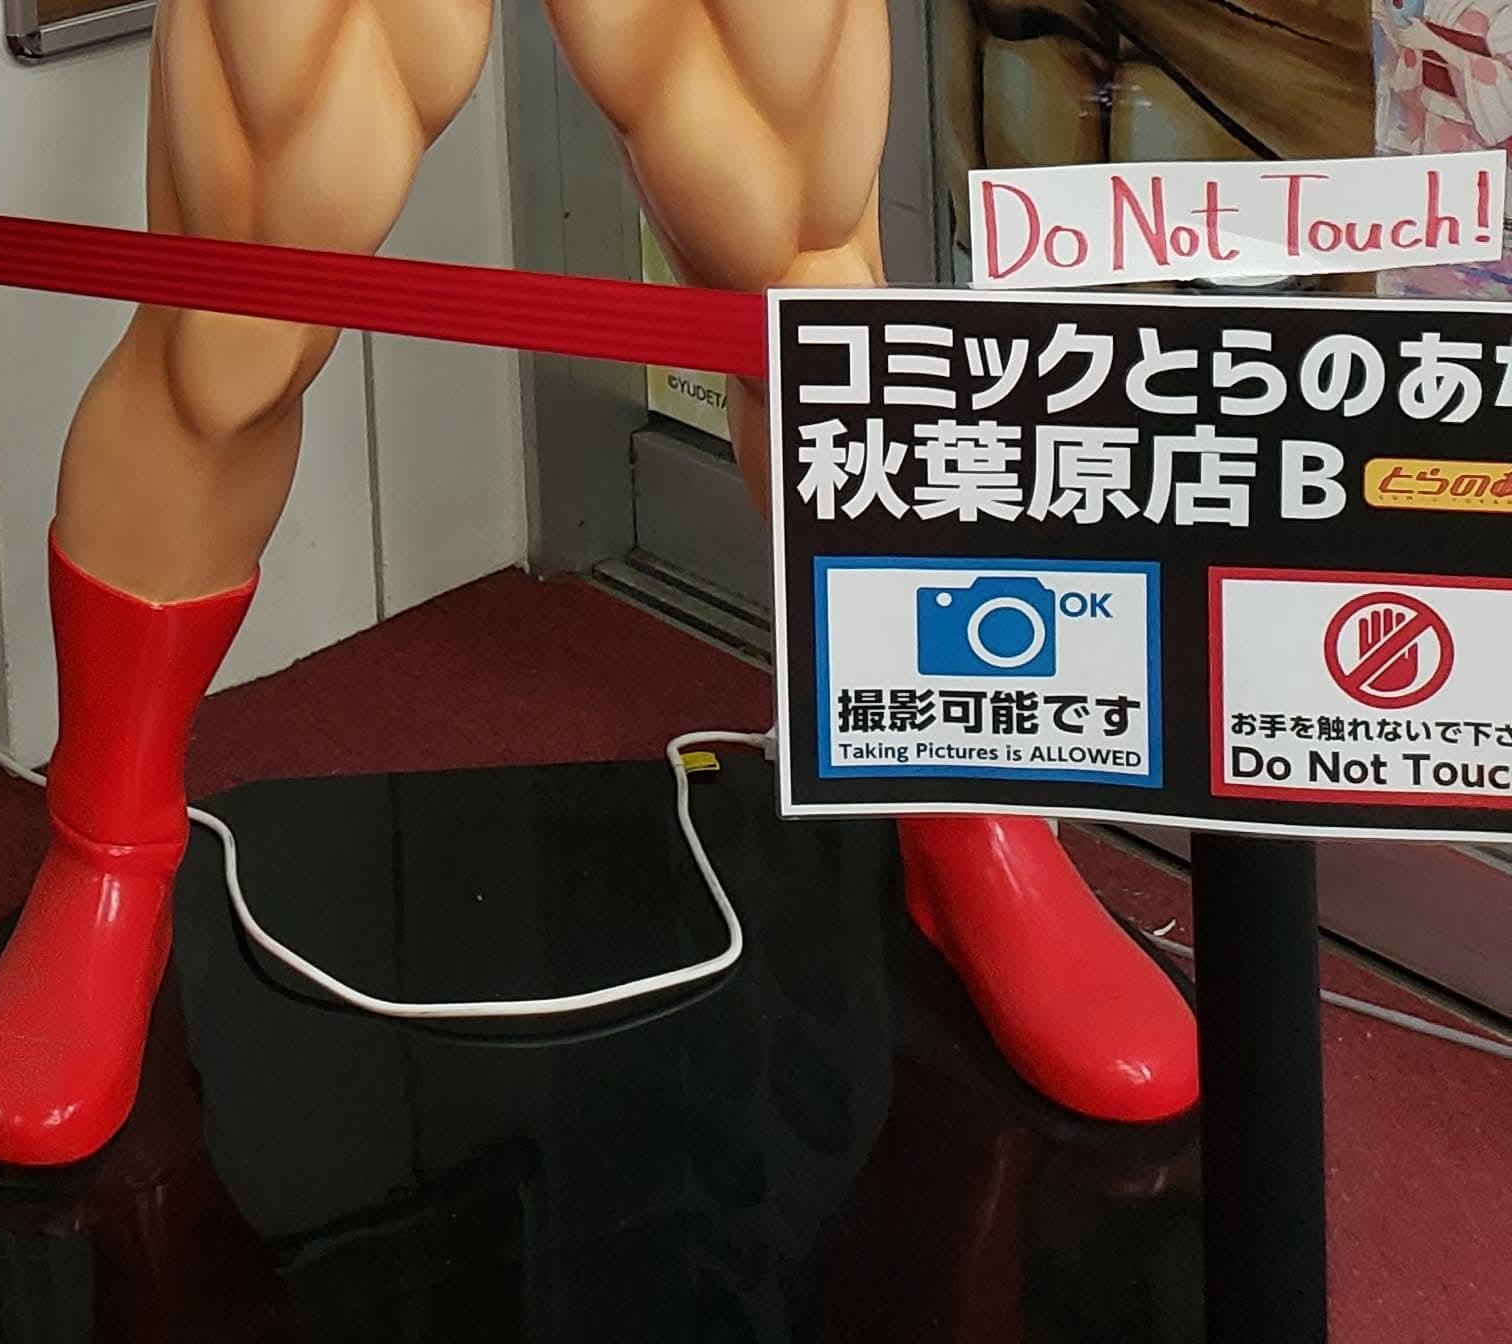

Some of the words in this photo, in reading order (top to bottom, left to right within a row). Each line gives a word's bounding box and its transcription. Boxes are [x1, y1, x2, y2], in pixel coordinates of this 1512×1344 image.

[982, 180, 1088, 279] Do
[1111, 175, 1240, 272] Not
[1260, 170, 1491, 257] Touch!
[798, 323, 1512, 423] コミックとらのあ
[798, 418, 1258, 527] 秋葉原店
[1281, 440, 1347, 519] B
[1059, 592, 1113, 618] OK
[838, 688, 1141, 737] 撮影可能です
[839, 743, 909, 763] Taking
[916, 742, 999, 761] Pictures
[1006, 744, 1022, 762] is
[1030, 746, 1142, 767] ALLOWED
[1231, 745, 1292, 781] Do
[1309, 750, 1388, 785] Not
